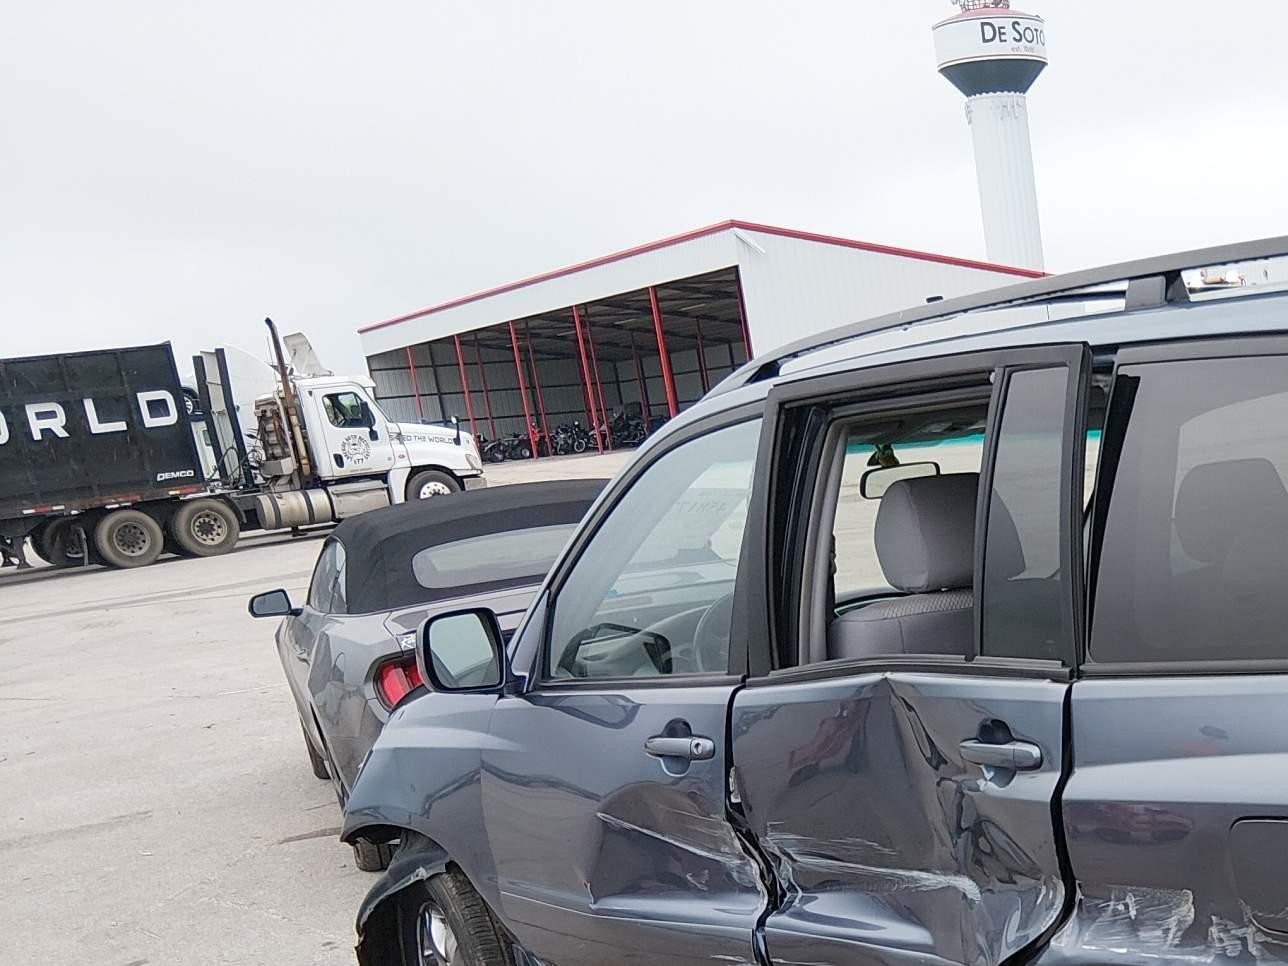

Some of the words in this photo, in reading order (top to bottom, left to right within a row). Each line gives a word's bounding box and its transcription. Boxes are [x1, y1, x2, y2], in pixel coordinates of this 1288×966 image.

[0, 390, 178, 445] RLD
[428, 436, 454, 444] WORLD
[157, 469, 194, 482] DEMCO
